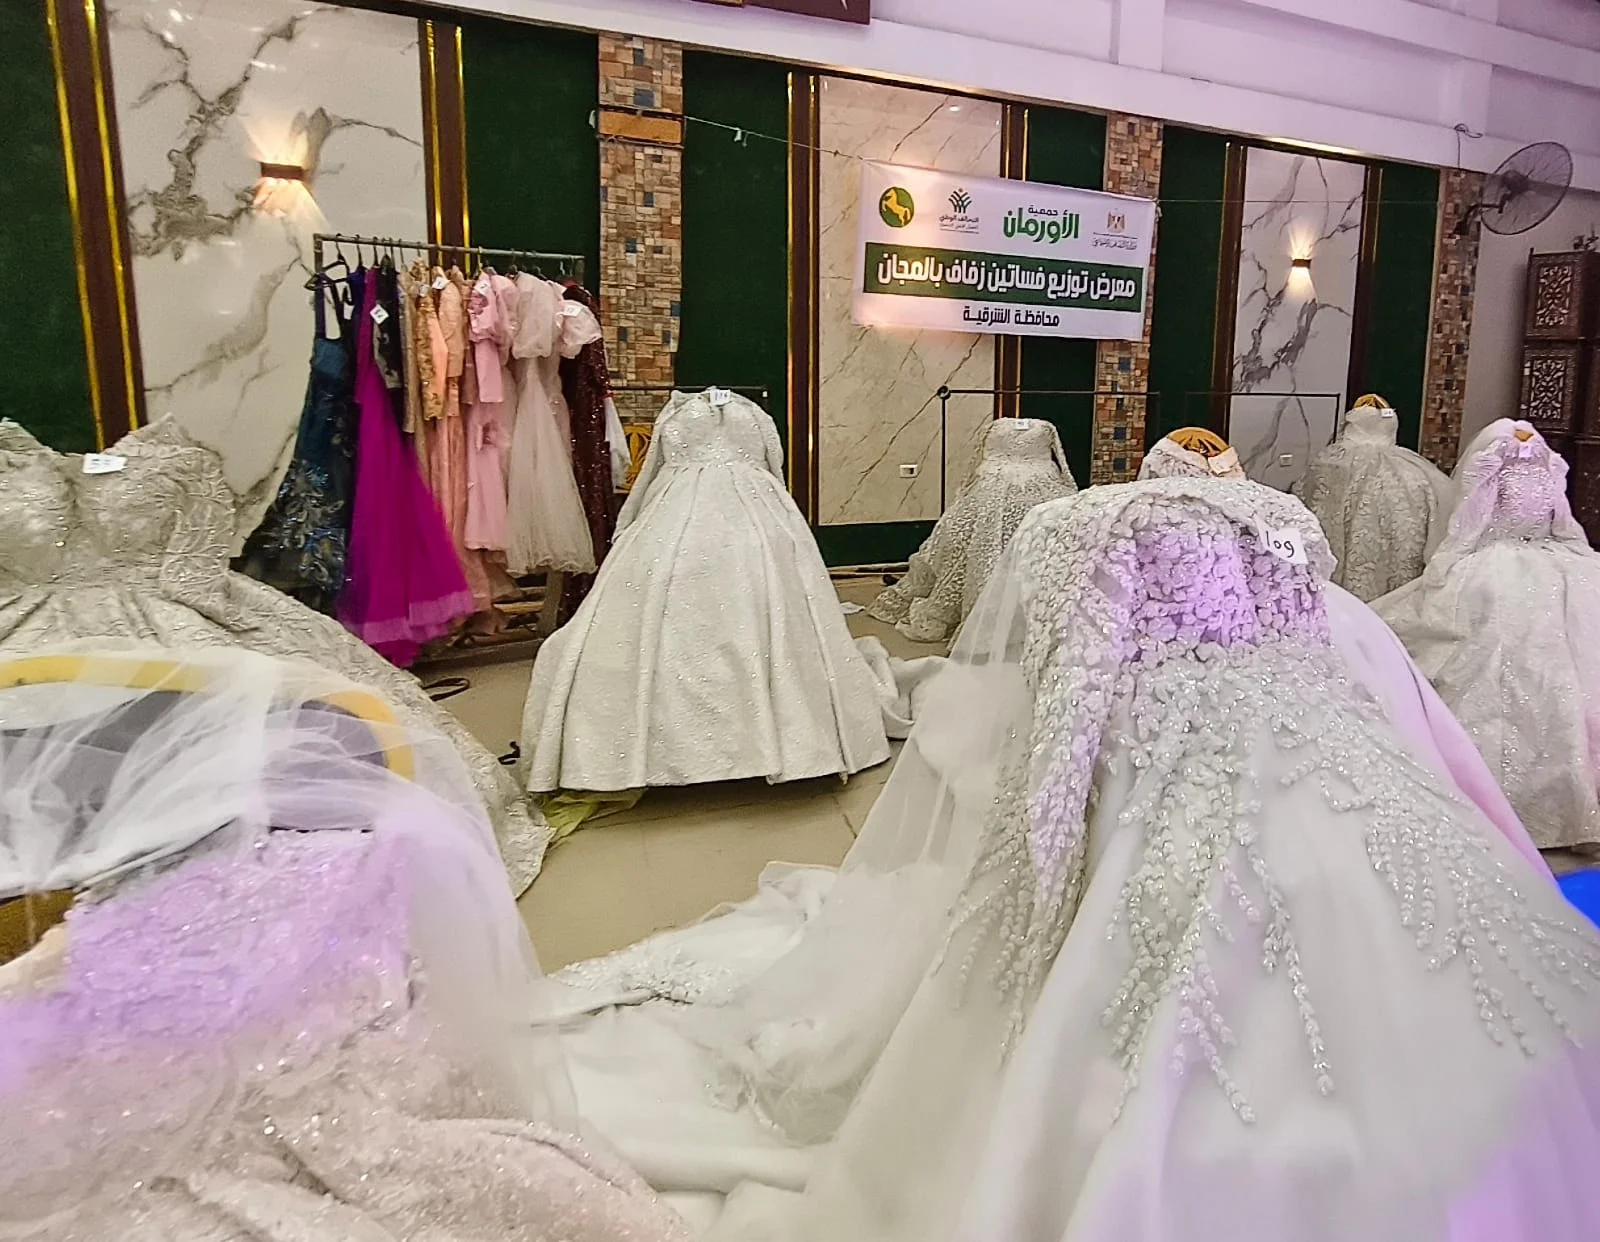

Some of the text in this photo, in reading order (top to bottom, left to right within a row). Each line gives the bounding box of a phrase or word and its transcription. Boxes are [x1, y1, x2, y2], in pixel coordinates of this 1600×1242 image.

[1028, 204, 1059, 217] جمعية
[1003, 207, 1080, 244] الأورمان
[877, 252, 1136, 300] معرض توزيع فساتين زفاف بالمجان
[963, 305, 1060, 327] محافظة الشرقية
[1265, 530, 1295, 558] 109
